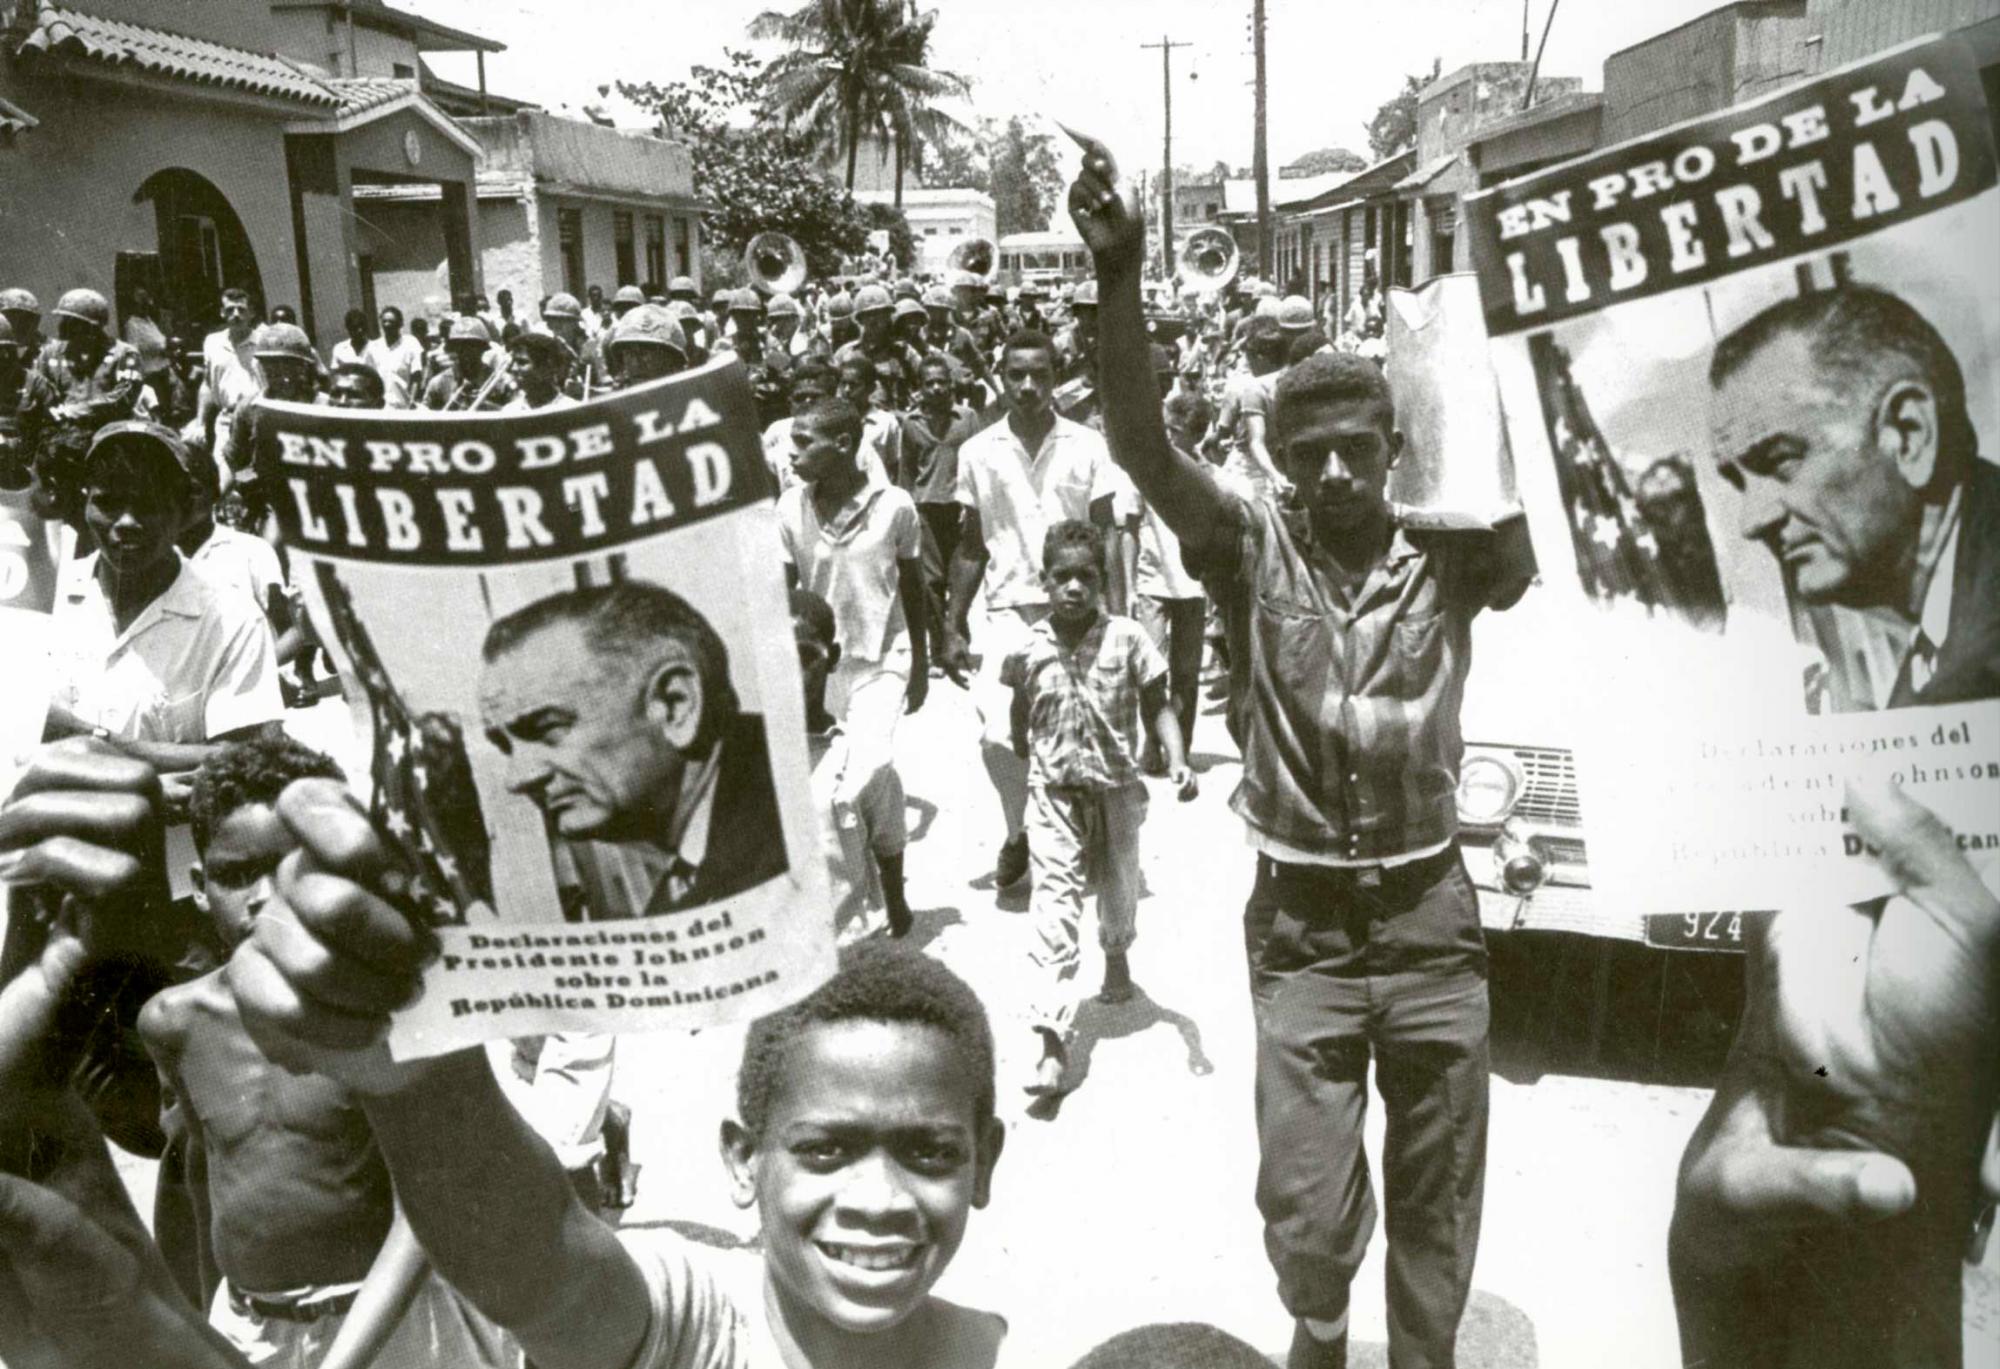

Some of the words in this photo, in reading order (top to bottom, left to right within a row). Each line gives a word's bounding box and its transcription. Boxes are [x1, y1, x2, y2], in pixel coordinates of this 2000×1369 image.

[1497, 190, 1572, 239] EN
[1588, 145, 1716, 210] PRO
[1730, 104, 1830, 166] DE
[1849, 67, 1946, 127] LA
[1505, 118, 1961, 316] LIBERTAD
[276, 431, 347, 469] EN
[365, 440, 497, 475] PRO
[515, 424, 616, 470] DE
[632, 398, 722, 444] LA
[288, 442, 734, 552] LIBERTAD
[1931, 721, 1971, 747] del
[1890, 760, 2000, 785] ohnson
[468, 929, 678, 951] Declaraciones
[687, 910, 734, 941] del
[1683, 912, 1742, 941] 924
[444, 952, 619, 972] Presidente
[633, 927, 767, 968] Johnson
[450, 992, 597, 1018] República
[605, 968, 780, 1011] Dominicana
[554, 971, 632, 989] sobre
[640, 971, 669, 987] la
